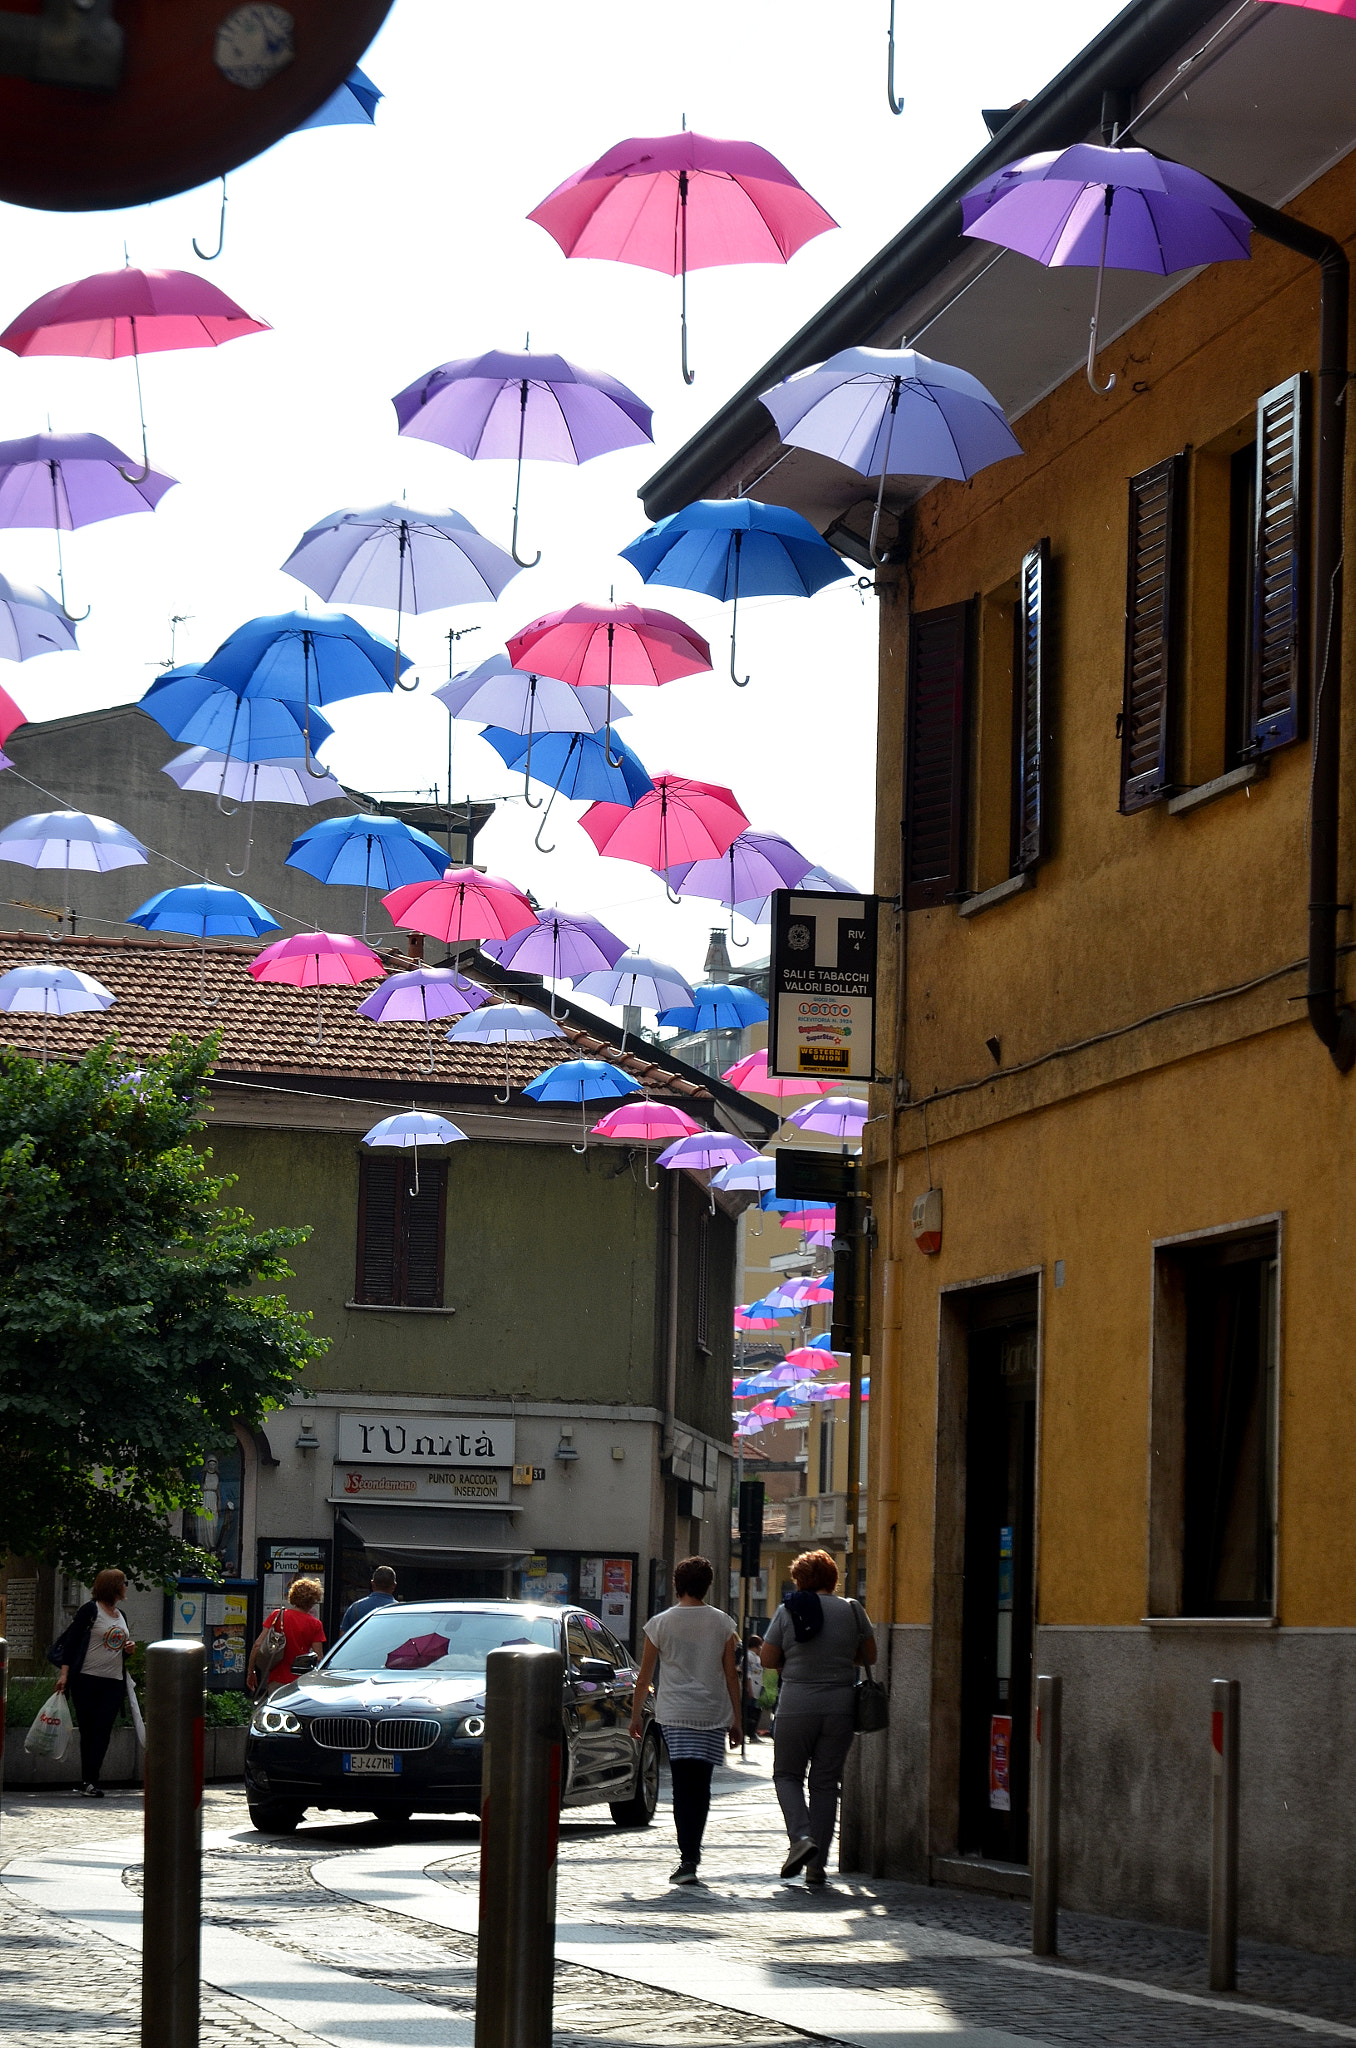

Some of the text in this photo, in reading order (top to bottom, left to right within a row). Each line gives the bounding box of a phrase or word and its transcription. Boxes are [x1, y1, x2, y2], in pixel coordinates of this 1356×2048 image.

[790, 896, 865, 968] T
[848, 930, 866, 940] RIV.
[853, 942, 860, 951] 4
[783, 969, 869, 982] SALI E TABACCHI
[784, 981, 867, 994] VALORI BOLLATI
[799, 1003, 851, 1016] LOTTO
[800, 1048, 841, 1056] WESTERN
[813, 1054, 841, 1062] UNION
[428, 1473, 498, 1486] PUNTO RACCOLTA
[533, 1469, 543, 1480] 31
[346, 1473, 417, 1493] Secondamano
[454, 1486, 498, 1497] INSERZIONI
